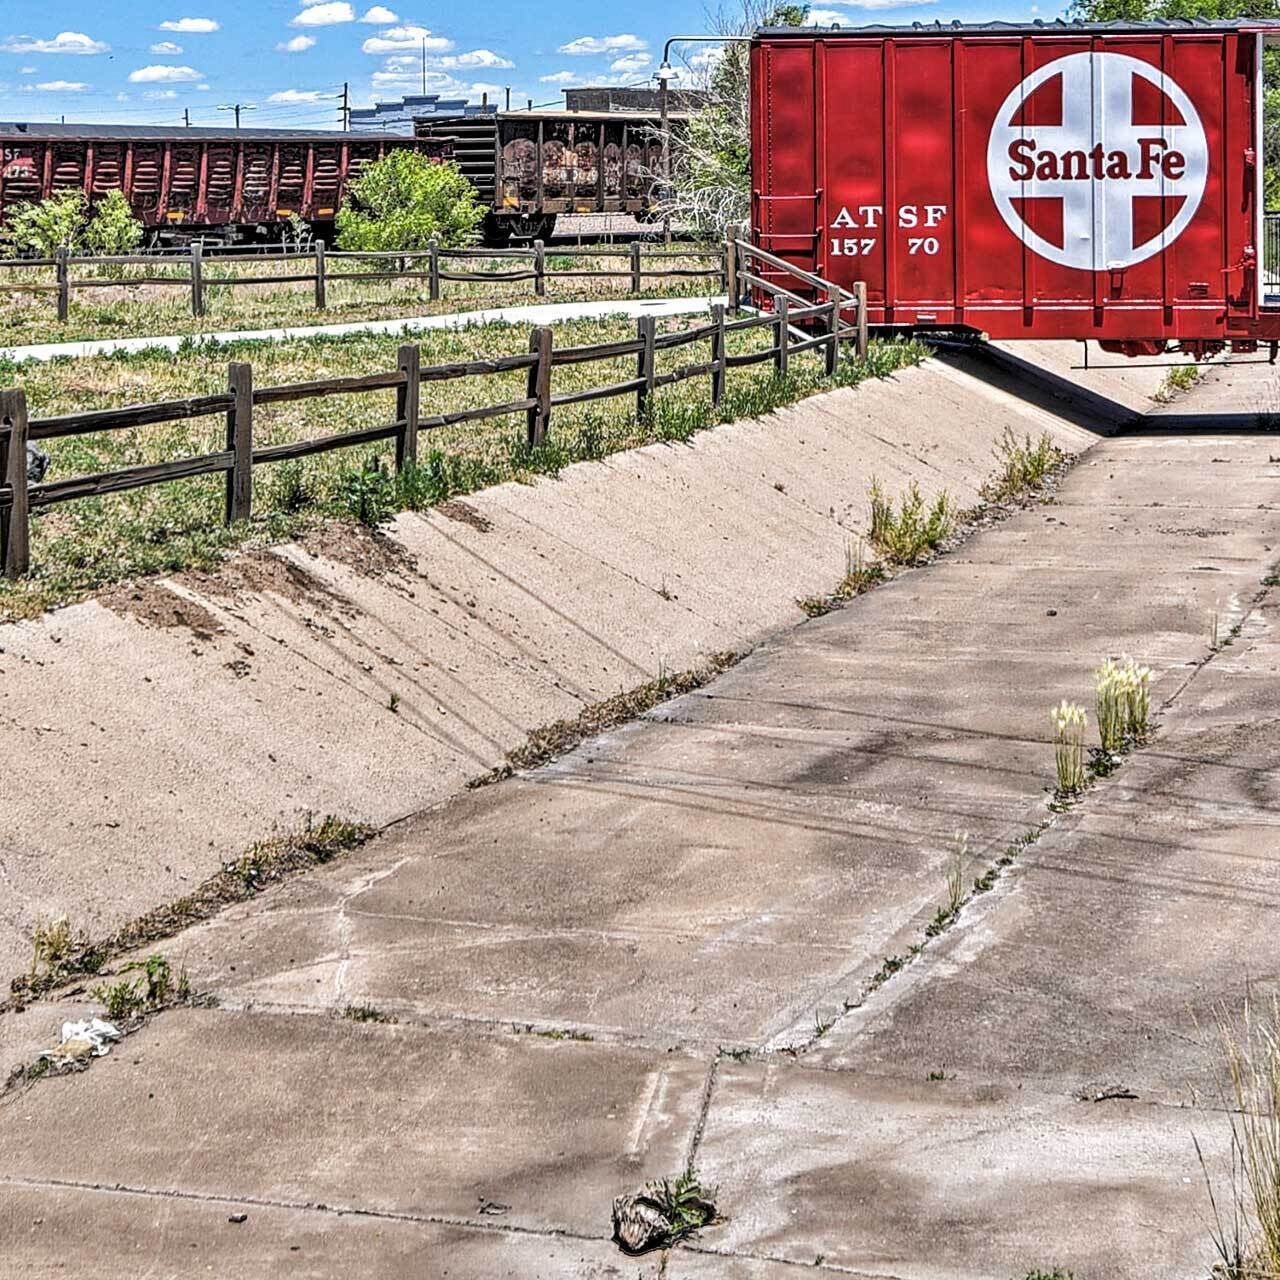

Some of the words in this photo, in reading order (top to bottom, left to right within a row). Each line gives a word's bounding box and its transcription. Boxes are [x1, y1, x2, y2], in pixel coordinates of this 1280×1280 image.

[1007, 137, 1133, 182] Santa
[1135, 137, 1187, 181] Fe
[830, 237, 877, 256] 157
[908, 237, 940, 256] 70
